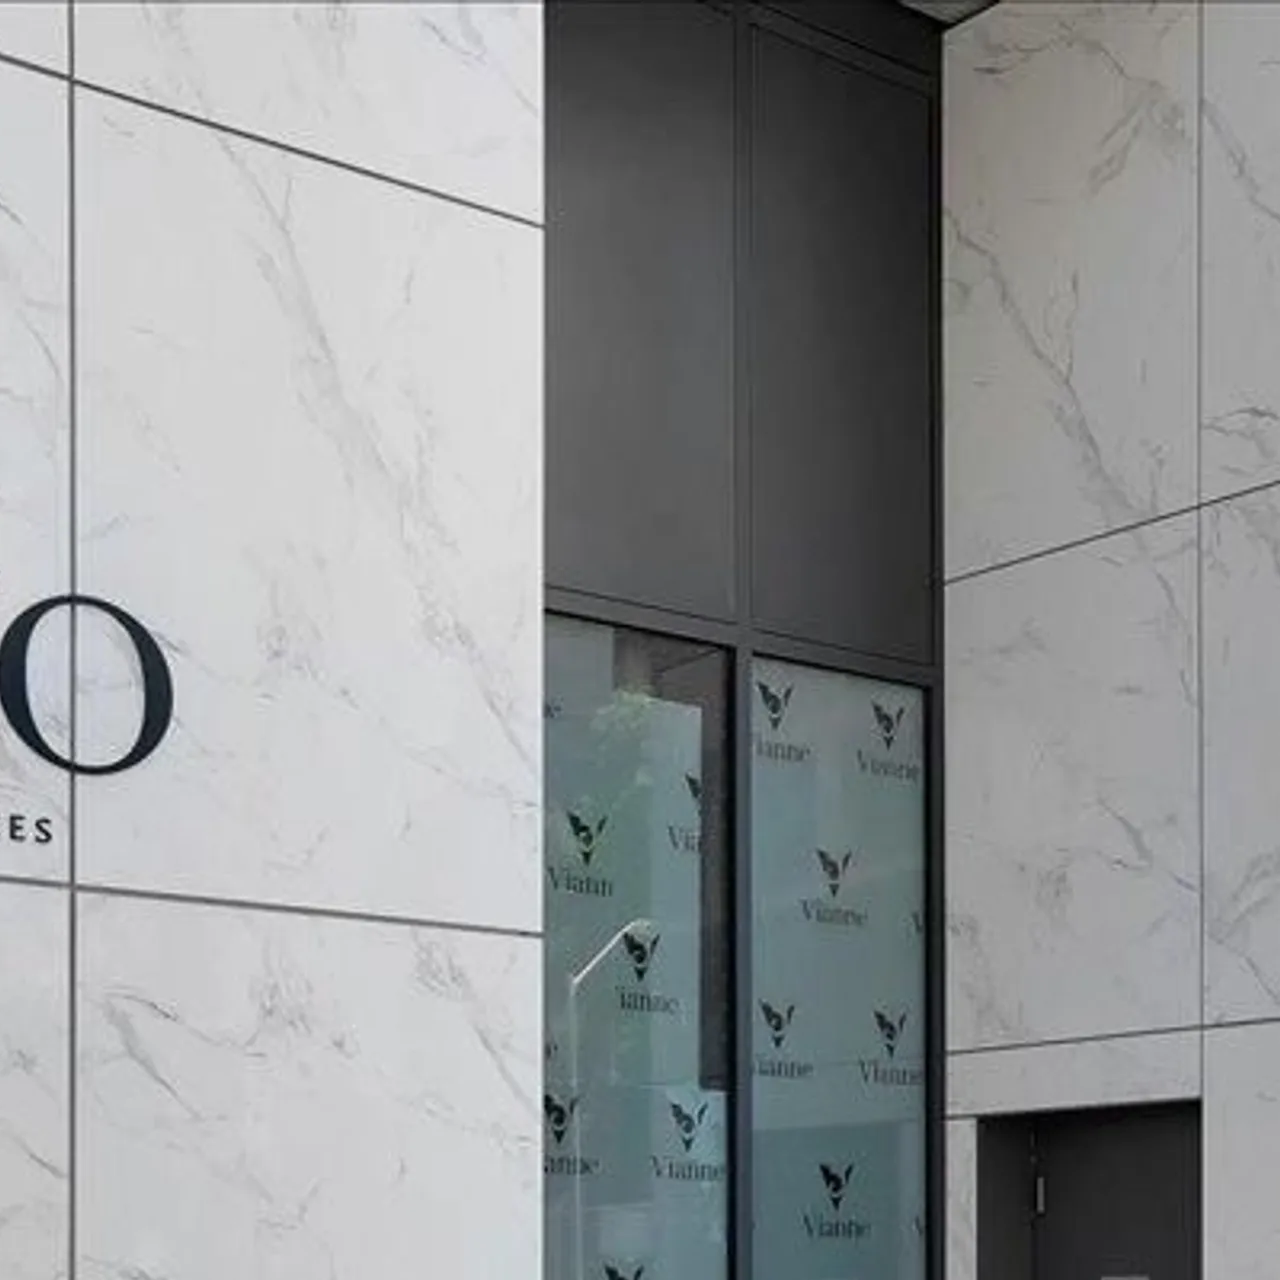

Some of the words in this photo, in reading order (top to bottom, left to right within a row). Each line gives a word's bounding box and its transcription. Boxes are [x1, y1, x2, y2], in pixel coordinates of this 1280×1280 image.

[754, 739, 812, 764] ianne
[547, 865, 613, 898] Viann
[614, 985, 681, 1016] ianne
[754, 1060, 814, 1081] ianne
[803, 1213, 872, 1241] Vianne
